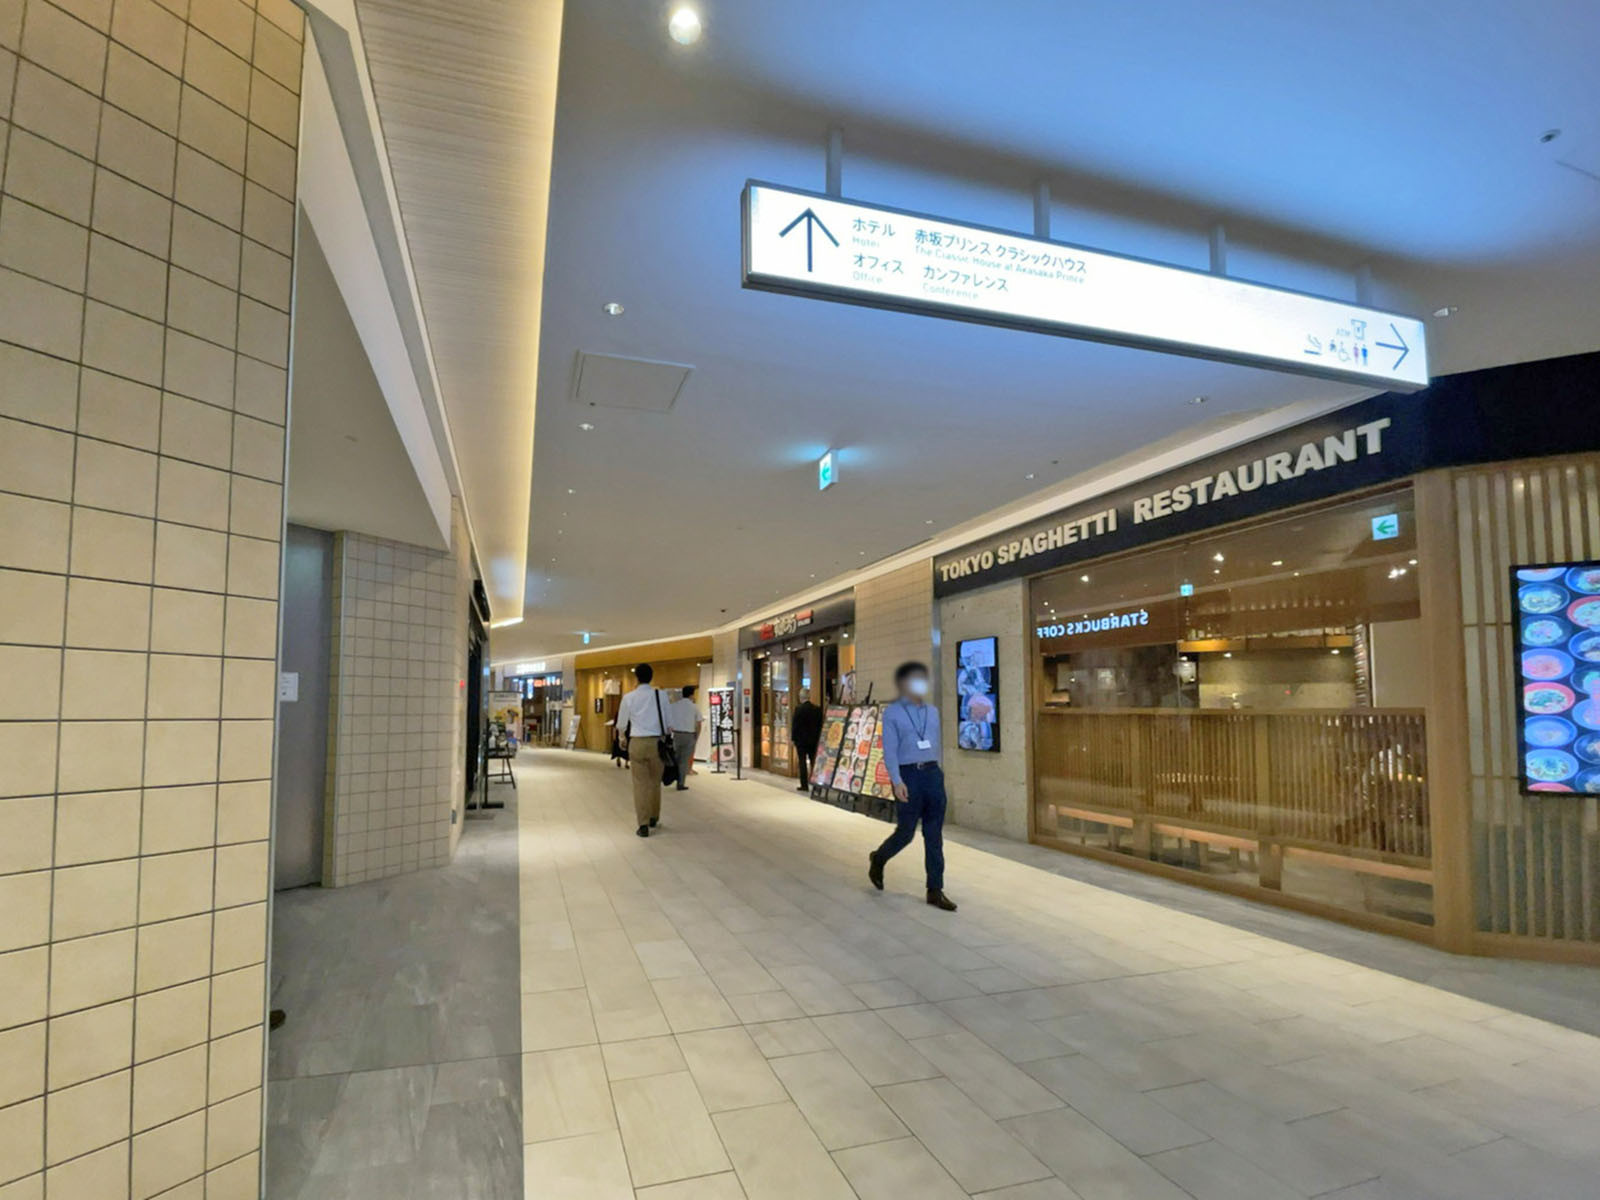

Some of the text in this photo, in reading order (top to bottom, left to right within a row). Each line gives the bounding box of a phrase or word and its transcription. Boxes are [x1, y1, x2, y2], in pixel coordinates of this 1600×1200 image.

[852, 217, 896, 237] ホテル
[852, 252, 905, 274] オフィス
[914, 229, 1088, 274] 赤坂プリンス クラシックハウス
[923, 264, 1009, 292] カンファレンス
[922, 283, 979, 300] Conference
[940, 417, 1391, 583] TOKYO SPAGHETTI RESTAURANT
